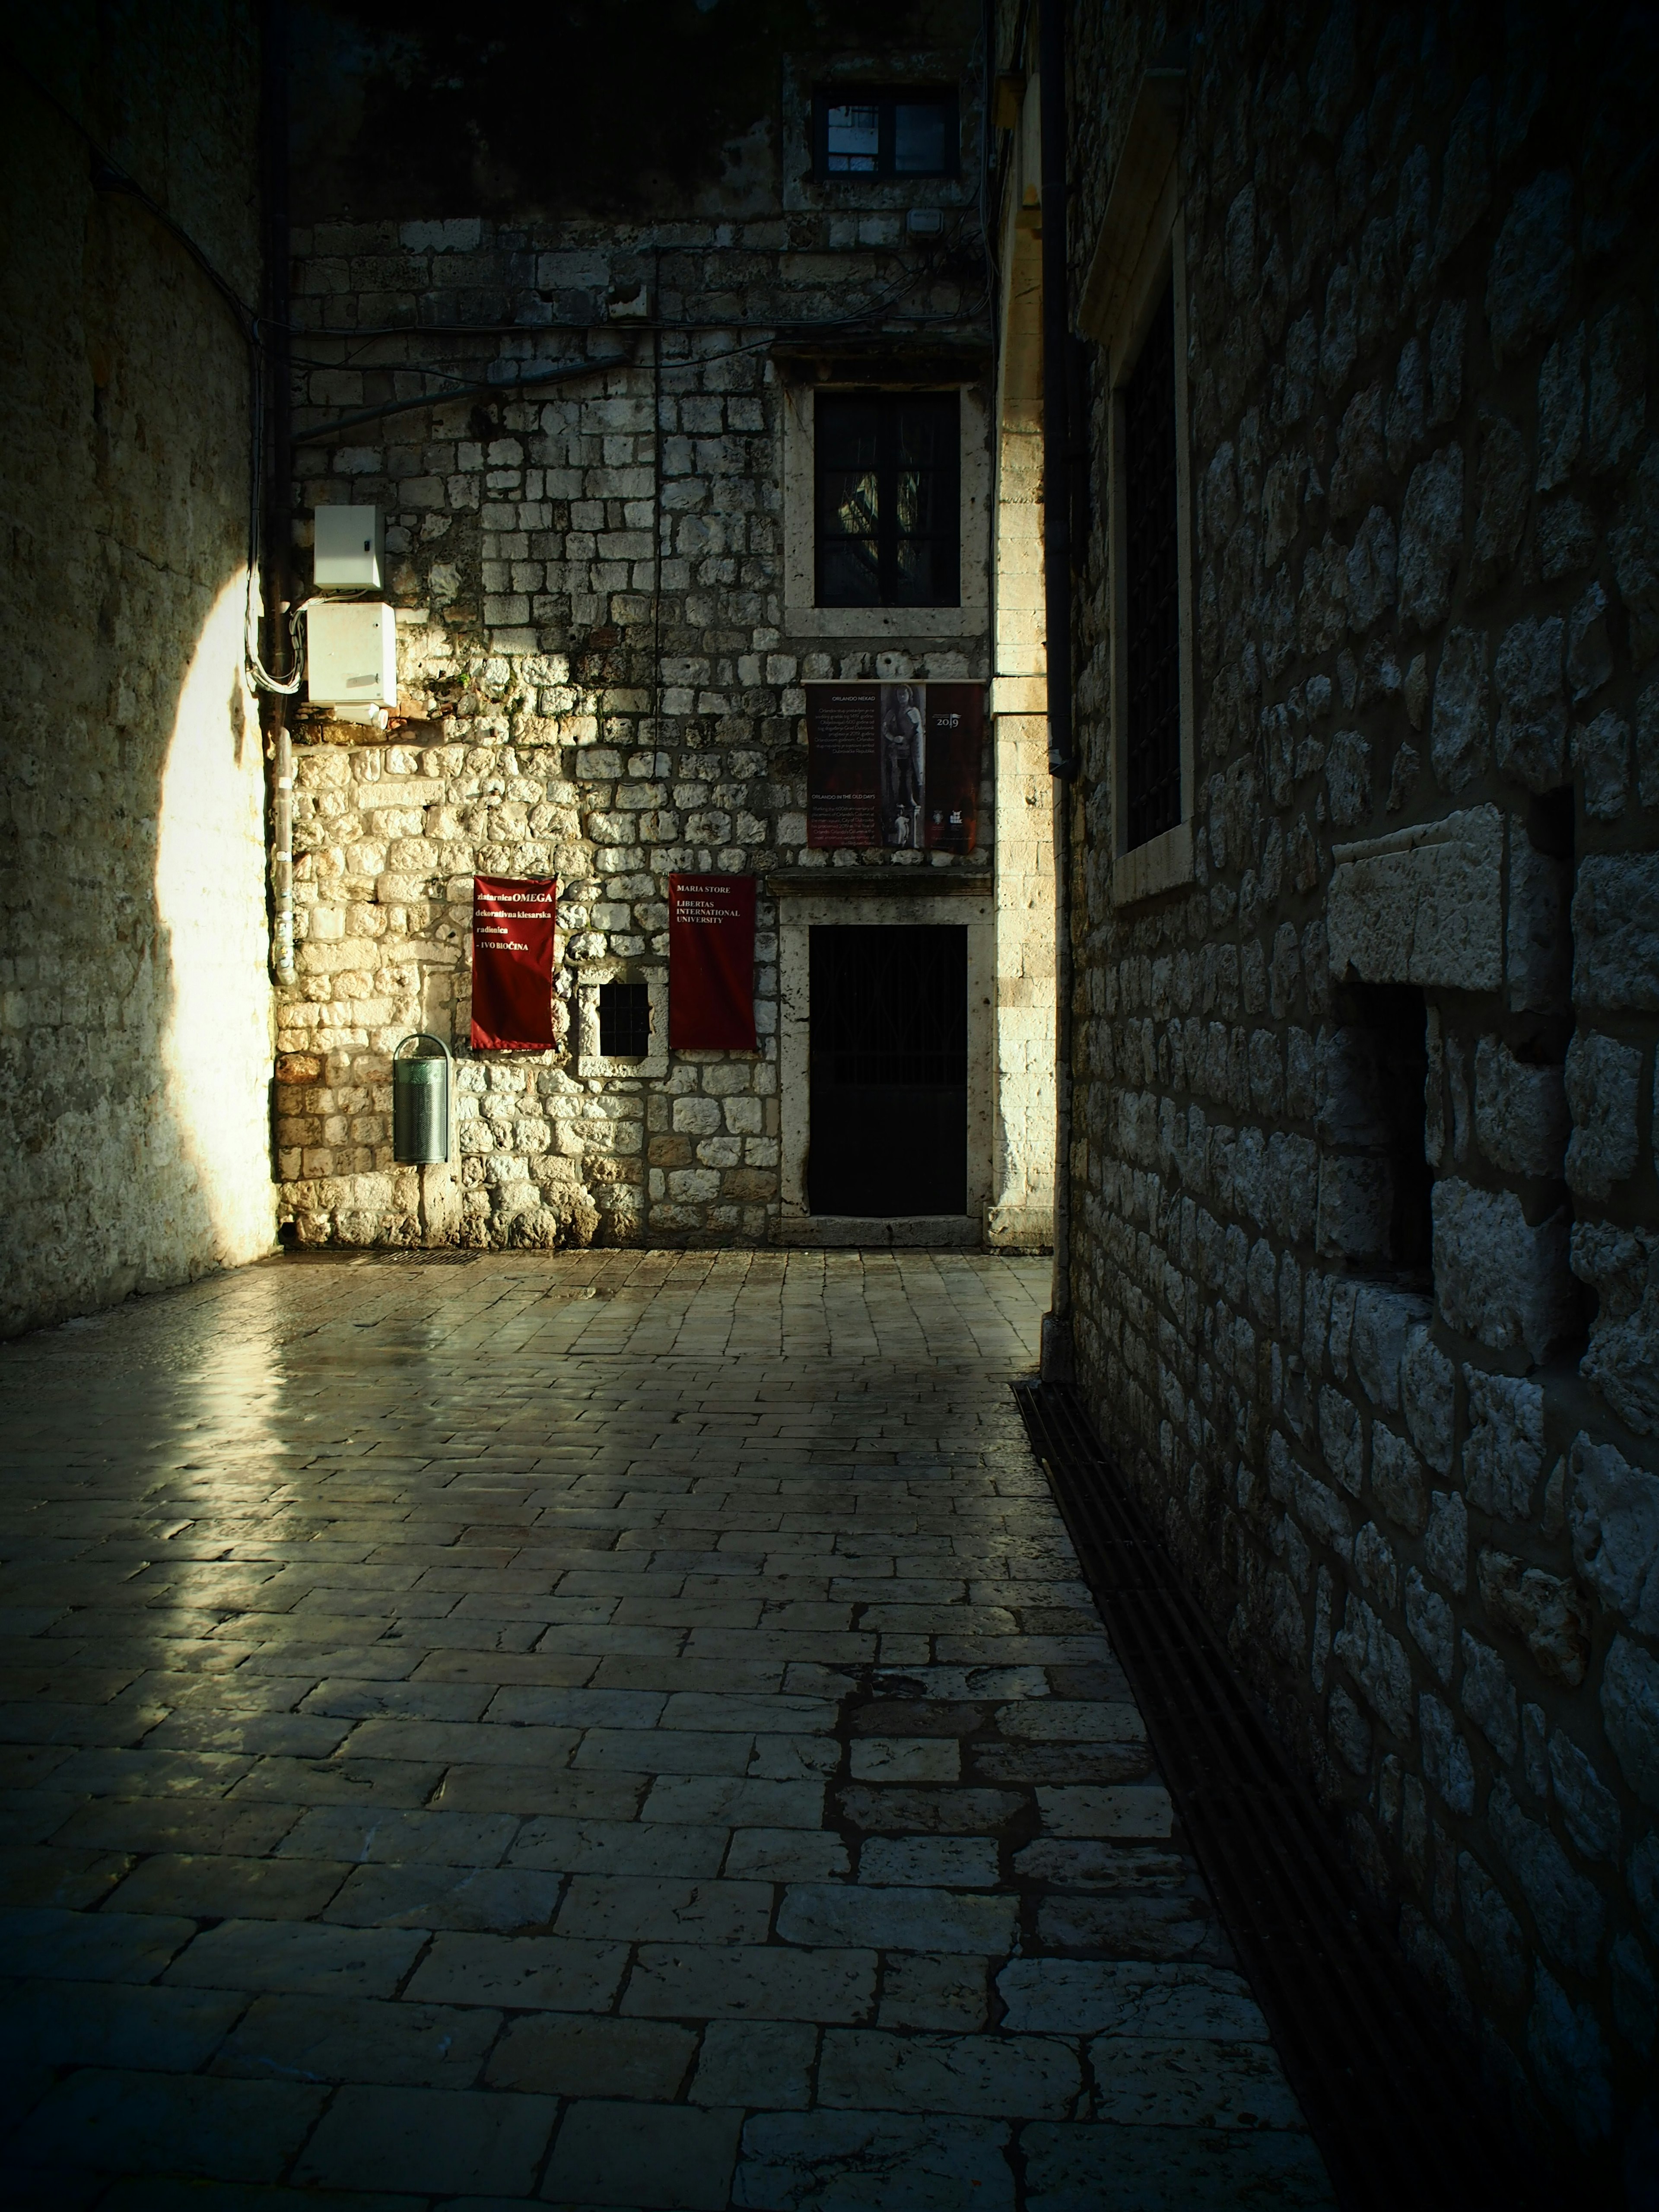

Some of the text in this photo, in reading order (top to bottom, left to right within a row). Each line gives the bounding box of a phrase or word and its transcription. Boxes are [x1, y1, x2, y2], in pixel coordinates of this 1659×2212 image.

[937, 718, 959, 729] 2019
[477, 893, 553, 903] zlatarnica OMEGA
[475, 909, 517, 918] dekorativna
[677, 908, 741, 917] INTERNATIONAL
[476, 926, 509, 934] radionica
[496, 941, 529, 950] BIOČINA
